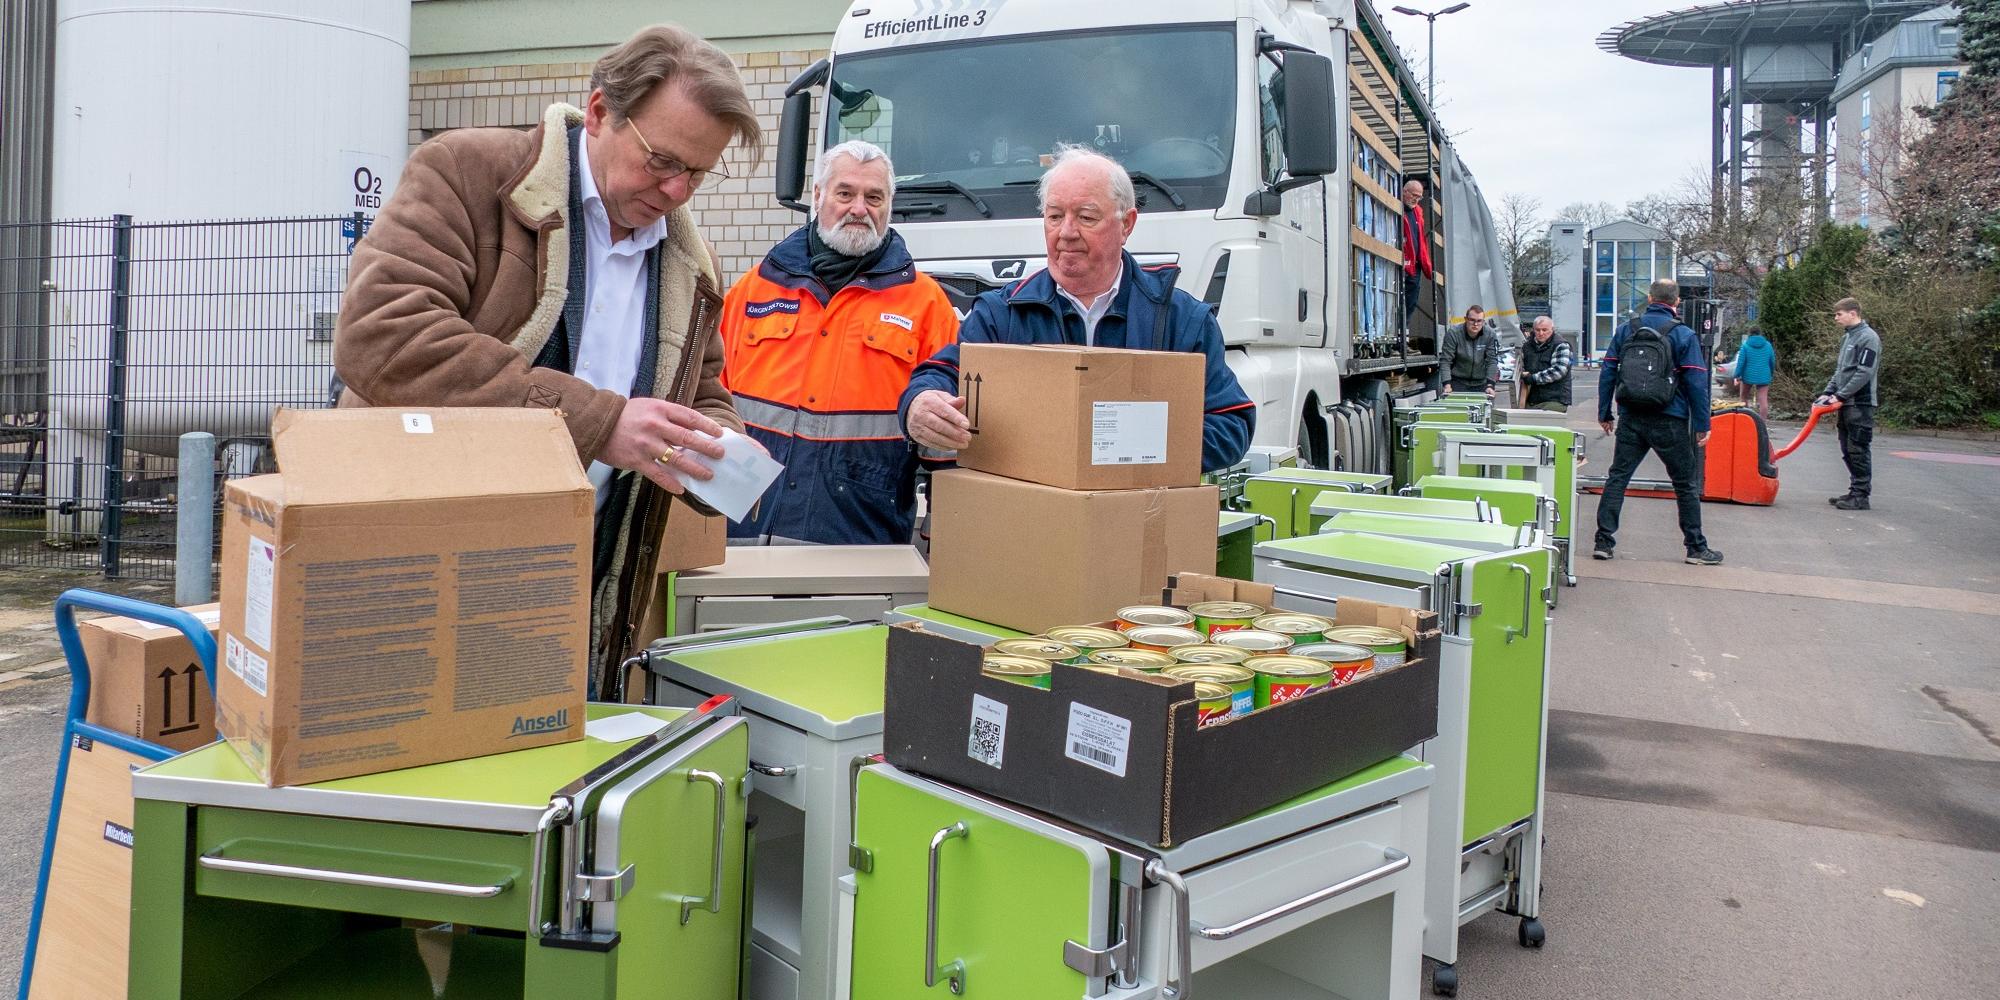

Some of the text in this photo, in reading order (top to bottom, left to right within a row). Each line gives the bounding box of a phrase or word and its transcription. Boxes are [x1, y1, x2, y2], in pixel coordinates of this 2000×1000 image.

[864, 9, 987, 38] EfficientLine 3
[355, 194, 381, 208] MED
[412, 418, 418, 427] 6
[1272, 686, 1286, 700] GUT
[1232, 695, 1252, 711] OFFEL
[511, 708, 568, 734] Ansell
[105, 824, 134, 846] Mitarbeite
